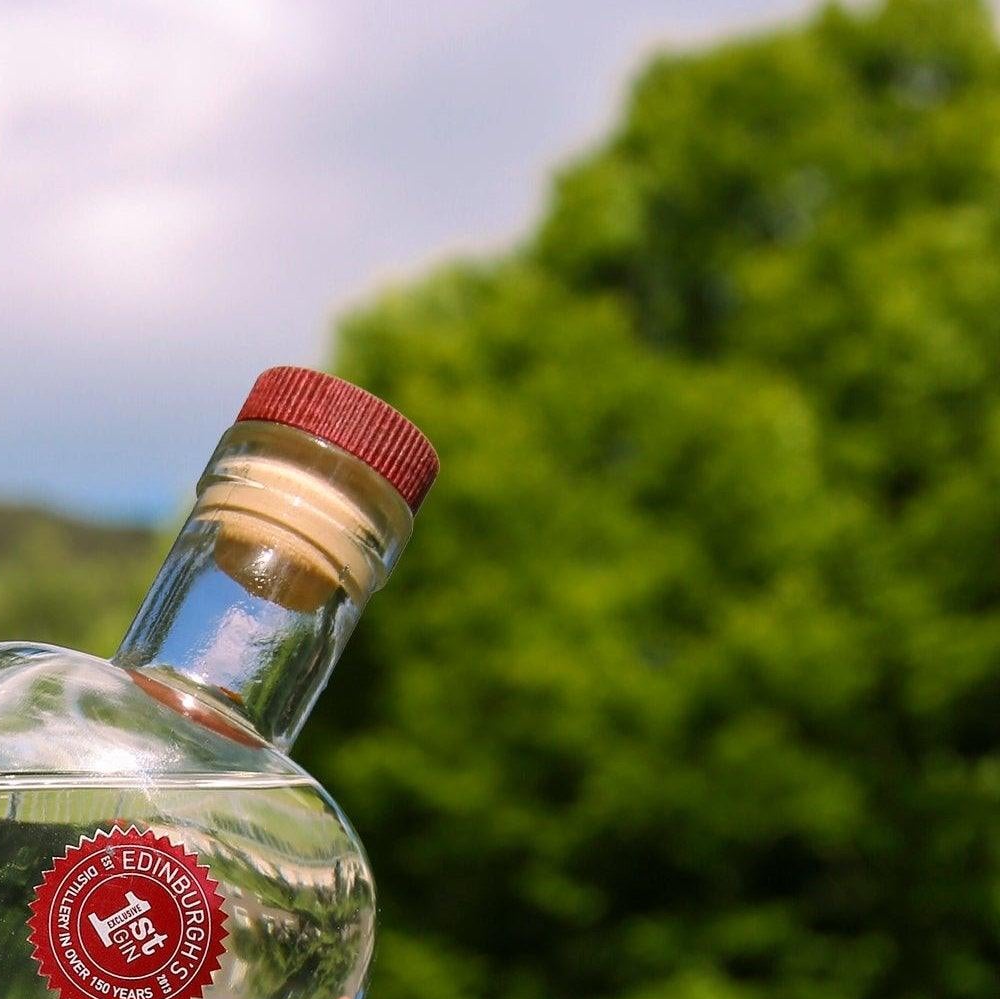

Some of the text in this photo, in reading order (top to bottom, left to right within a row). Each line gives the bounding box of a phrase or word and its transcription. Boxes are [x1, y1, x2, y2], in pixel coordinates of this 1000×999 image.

[101, 855, 115, 871] EST
[57, 865, 98, 932] DISTILLERY
[106, 903, 143, 929] EXCLUSIVE
[122, 850, 205, 980] EDINBURGH'S
[58, 933, 72, 948] IN
[112, 929, 141, 964] GIN
[65, 949, 91, 981] OVER
[89, 976, 111, 994] 150
[156, 974, 173, 994] 2013
